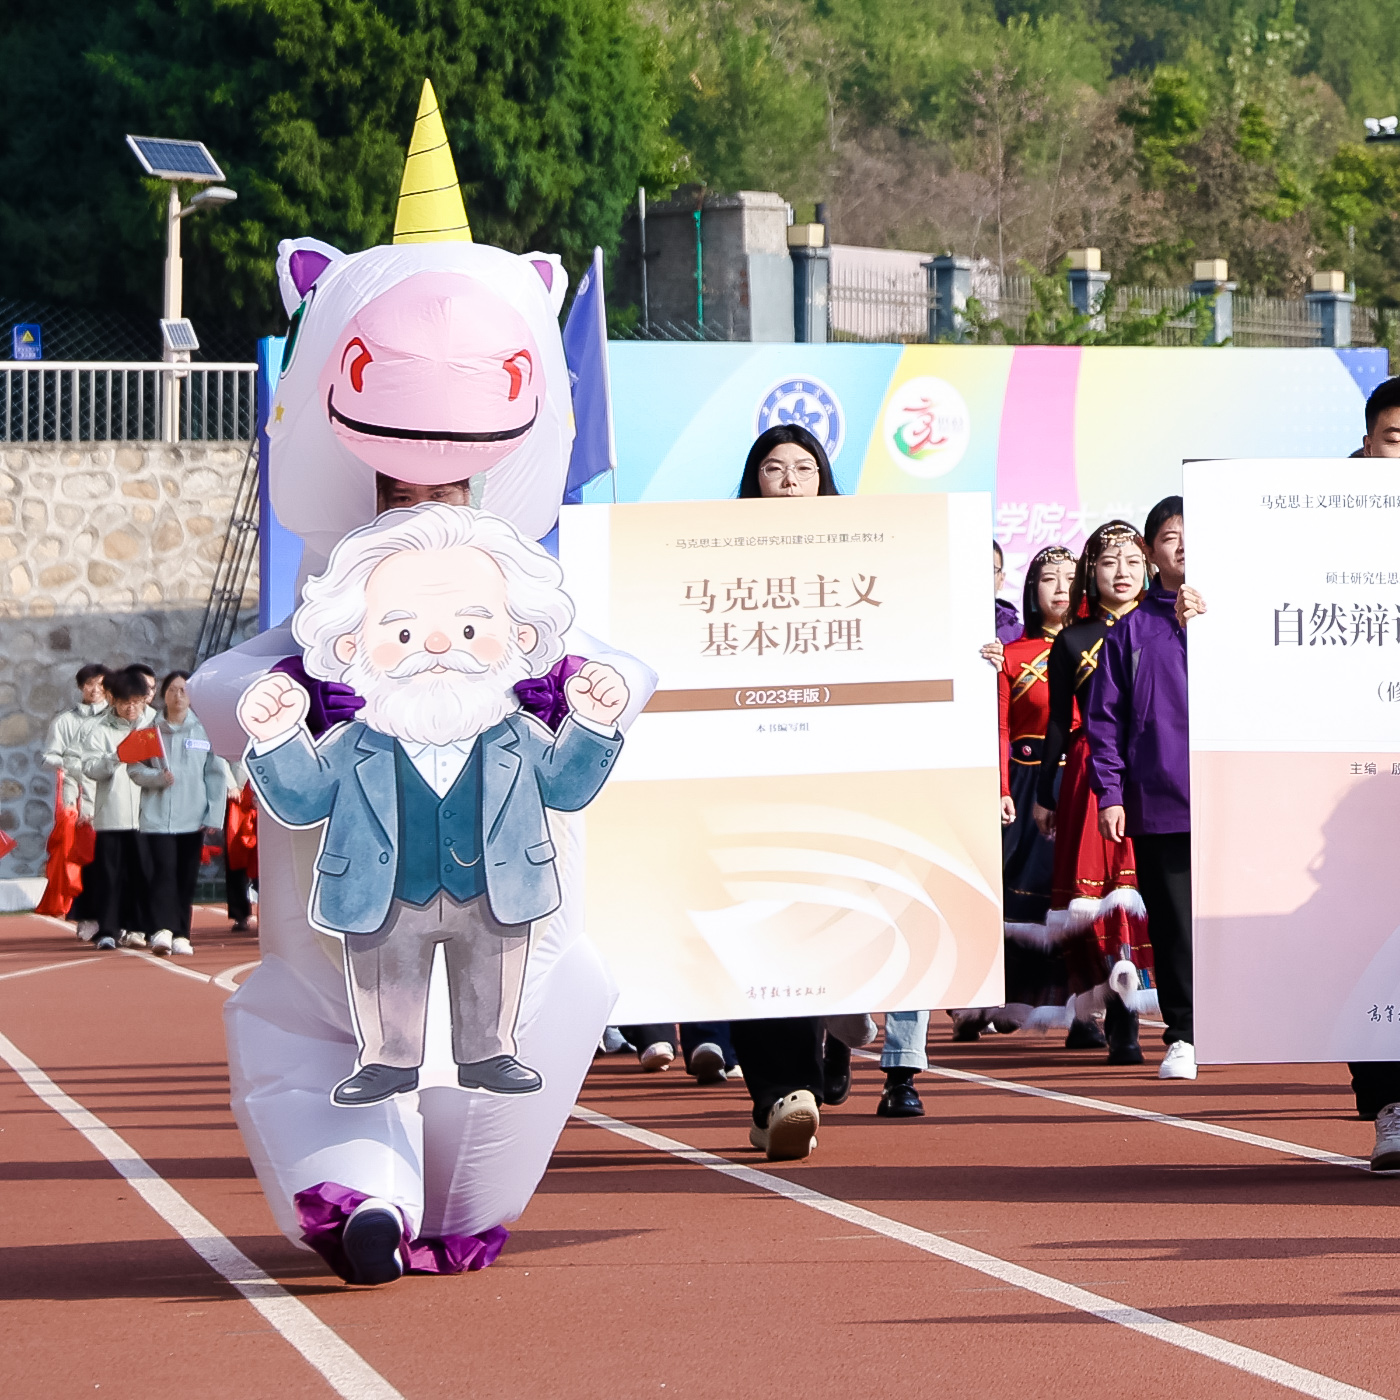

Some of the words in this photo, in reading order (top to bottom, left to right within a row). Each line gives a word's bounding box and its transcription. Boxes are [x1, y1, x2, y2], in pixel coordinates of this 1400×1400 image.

[675, 532, 884, 549] 马克思主义理论研究和建设工程重点教材
[679, 573, 884, 614] 马克思主义
[700, 617, 865, 658] 基本原理
[1350, 762, 1377, 775] 主编
